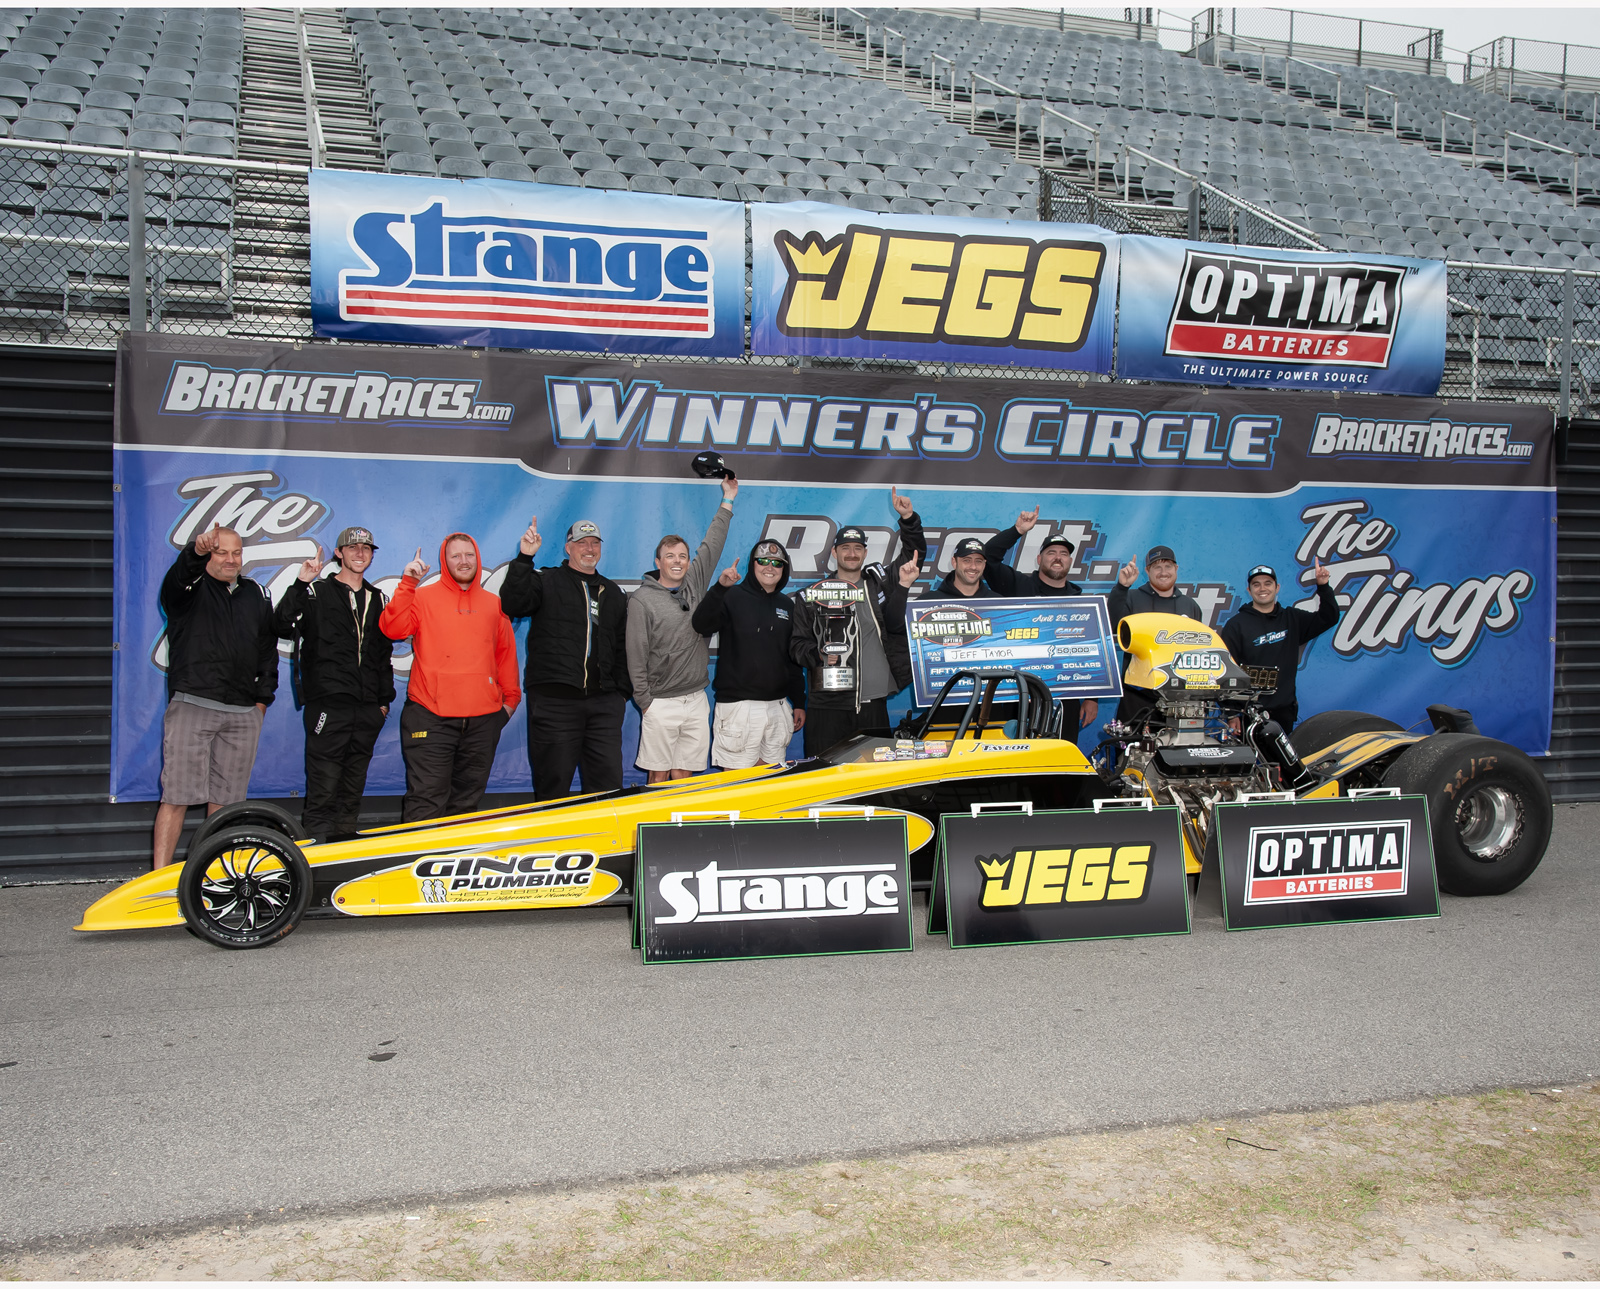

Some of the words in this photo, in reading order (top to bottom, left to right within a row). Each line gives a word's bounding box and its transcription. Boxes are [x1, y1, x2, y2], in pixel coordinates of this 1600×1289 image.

[345, 200, 710, 304] Strange
[783, 232, 1102, 344] JEGS
[1189, 265, 1389, 326] OPTIMA
[1221, 332, 1350, 357] BATTERIES
[1182, 364, 1206, 376] THE
[1210, 366, 1272, 380] ULTIMATE
[1276, 371, 1320, 382] POWER
[1323, 373, 1370, 384] SOURCE
[551, 376, 980, 453] WINNER'S
[1000, 403, 1274, 462] CIRCLE
[172, 473, 319, 546] The
[1296, 502, 1392, 562] The
[806, 589, 838, 601] SPRING
[840, 588, 864, 601] FLING
[1031, 614, 1054, 623] April
[1055, 614, 1068, 623] 25,
[1069, 613, 1091, 622] 2024
[1294, 555, 1529, 661] Flings
[911, 623, 955, 639] SPRING
[957, 619, 991, 636] FLING
[1005, 627, 1039, 640] JEGS
[1155, 630, 1213, 646] L422
[951, 650, 977, 660] JEFF
[930, 667, 956, 675] FIFTY
[981, 744, 1031, 752] TAYLOR
[1259, 832, 1399, 873] OPTIMA
[415, 853, 595, 878] GINCO
[978, 845, 1152, 907] JEGS
[451, 872, 591, 890] PLUMBING
[654, 860, 899, 925] Strange
[1285, 876, 1374, 894] BATTERIES
